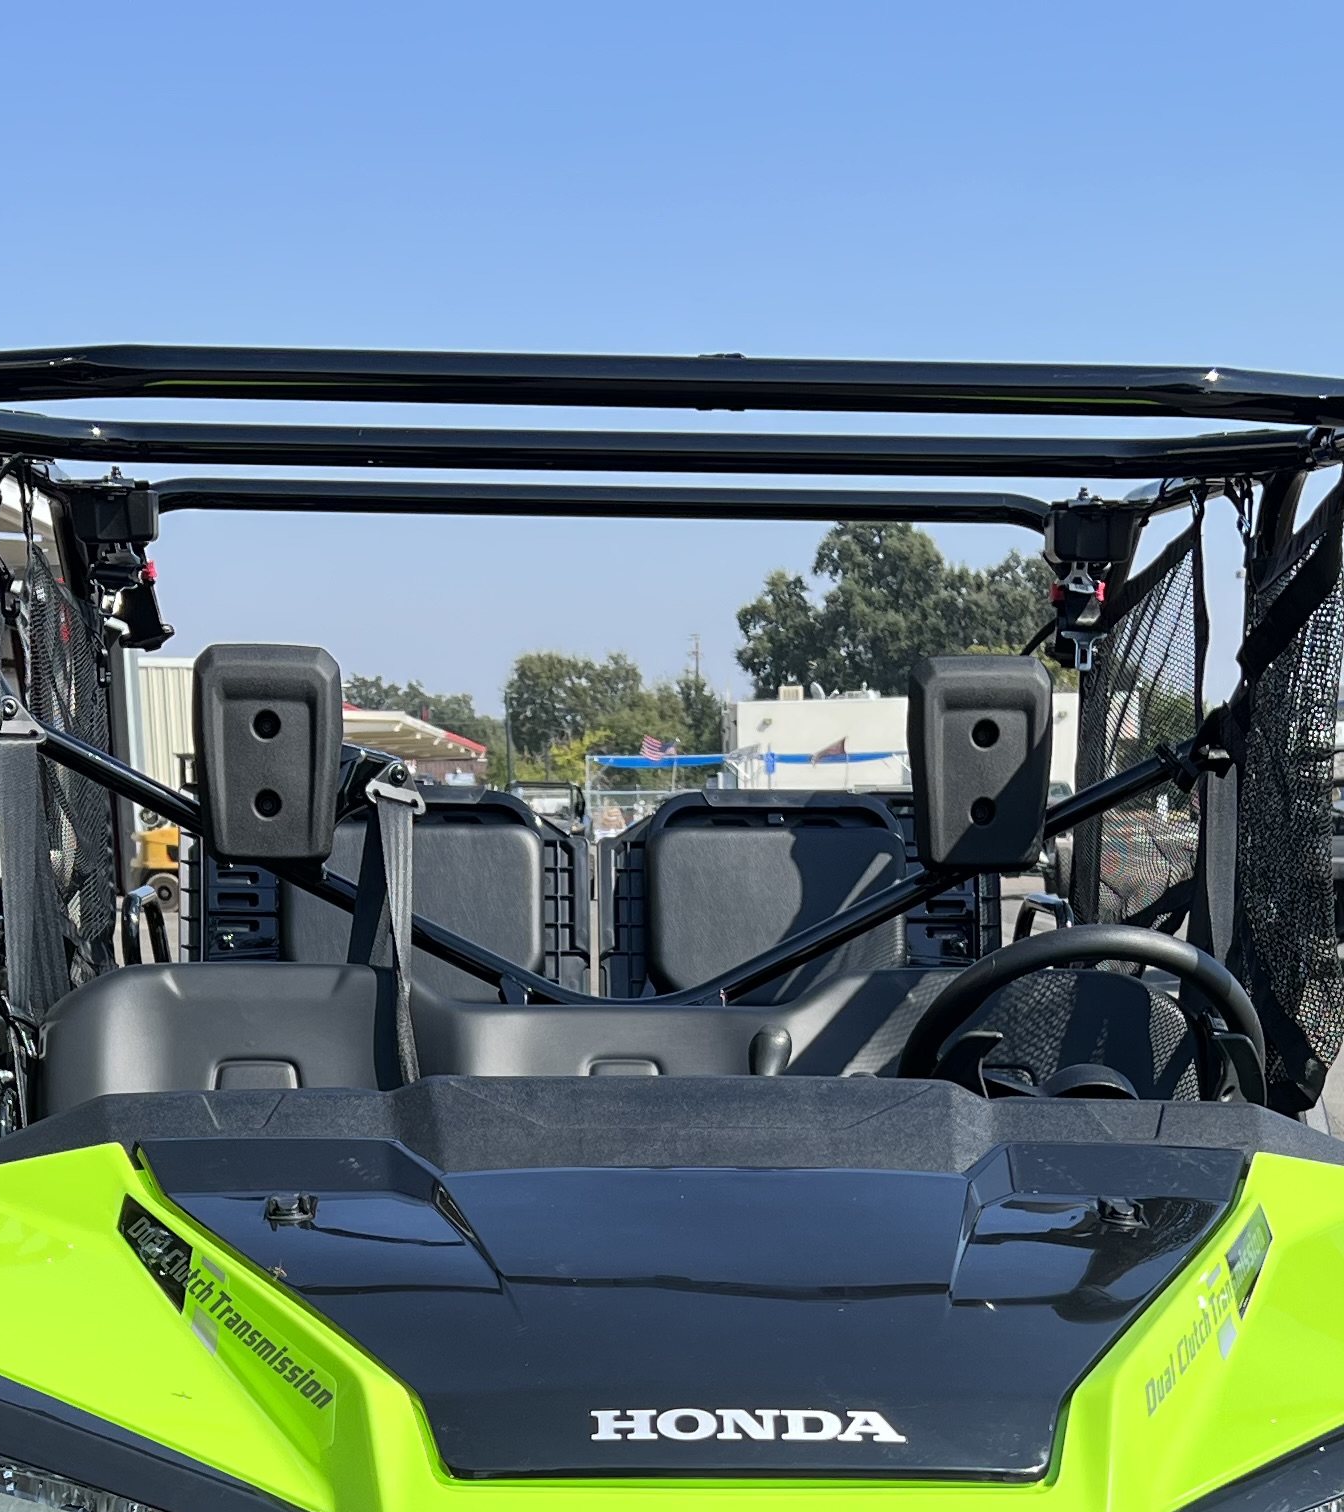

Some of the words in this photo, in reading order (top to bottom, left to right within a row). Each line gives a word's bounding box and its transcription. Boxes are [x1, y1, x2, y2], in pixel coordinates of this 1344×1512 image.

[128, 1216, 172, 1266] Dual
[166, 1247, 215, 1304] Clutch
[208, 1291, 334, 1410] Transmission
[1144, 1352, 1177, 1418] Dual
[1176, 1308, 1213, 1376] Clutch
[1208, 1225, 1267, 1325] Transmission
[590, 1408, 907, 1443] HONDA
